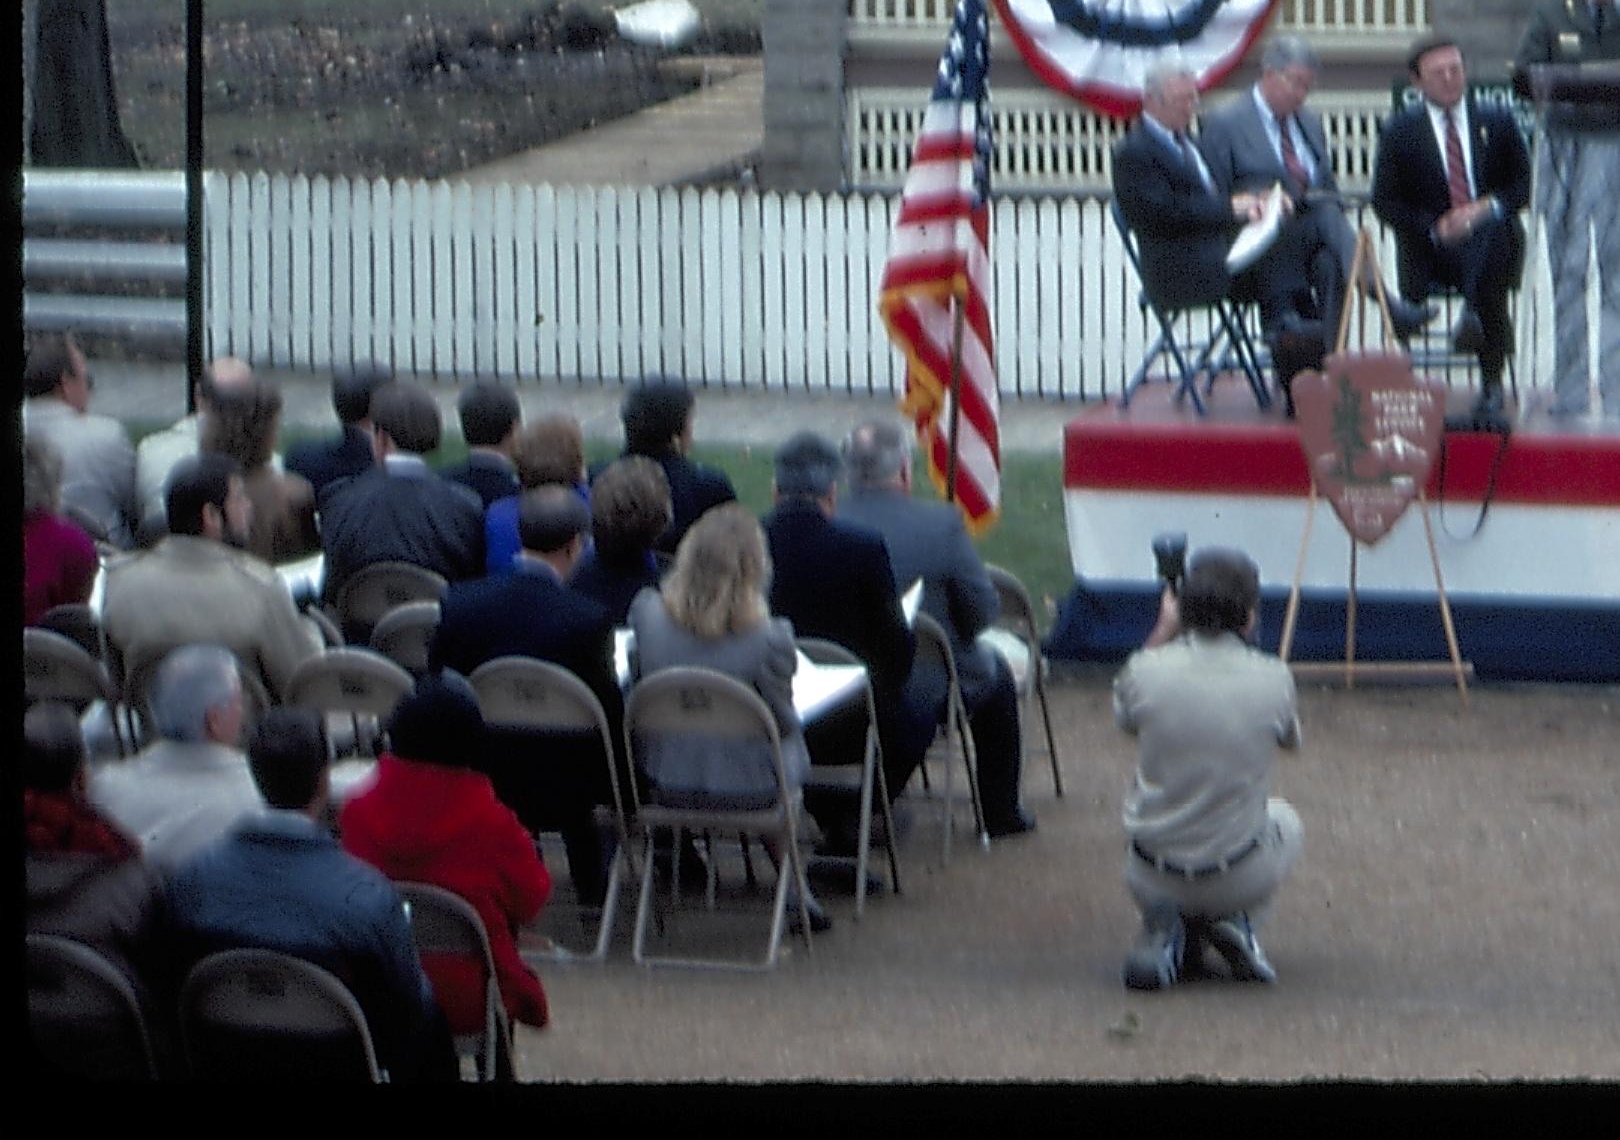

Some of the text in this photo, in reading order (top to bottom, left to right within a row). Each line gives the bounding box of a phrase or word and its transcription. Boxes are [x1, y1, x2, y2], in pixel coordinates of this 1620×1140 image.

[1371, 389, 1432, 403] NATIONAL
[1383, 403, 1417, 415] PARK
[1375, 417, 1425, 431] SERVICE
